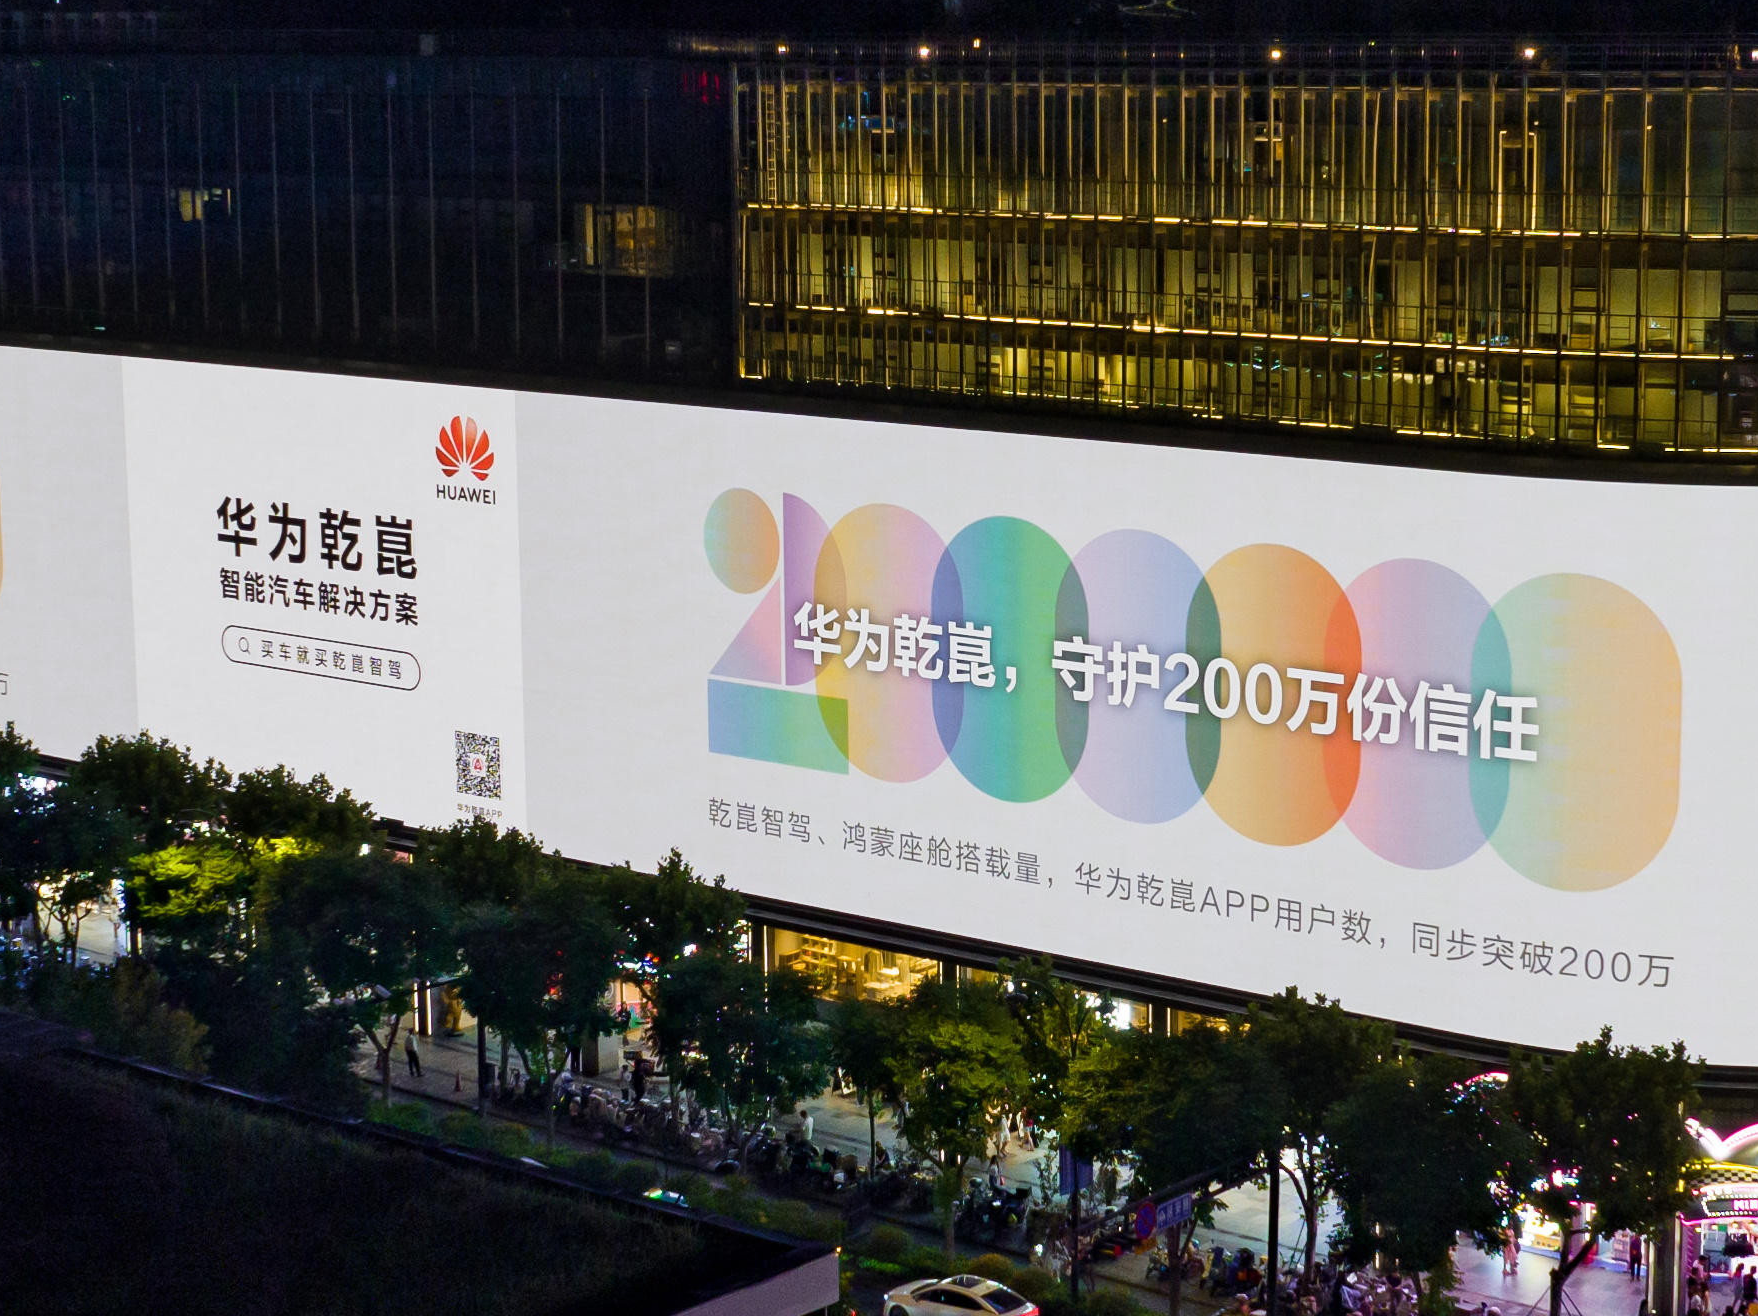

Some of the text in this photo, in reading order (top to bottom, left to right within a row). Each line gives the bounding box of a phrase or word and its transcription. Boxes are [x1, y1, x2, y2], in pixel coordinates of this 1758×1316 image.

[436, 484, 497, 505] HUAWEI
[216, 496, 417, 579] 华为乾崑
[220, 567, 418, 626] 智能汽车解决方案
[261, 639, 402, 680] 买车就买乾崑智驾
